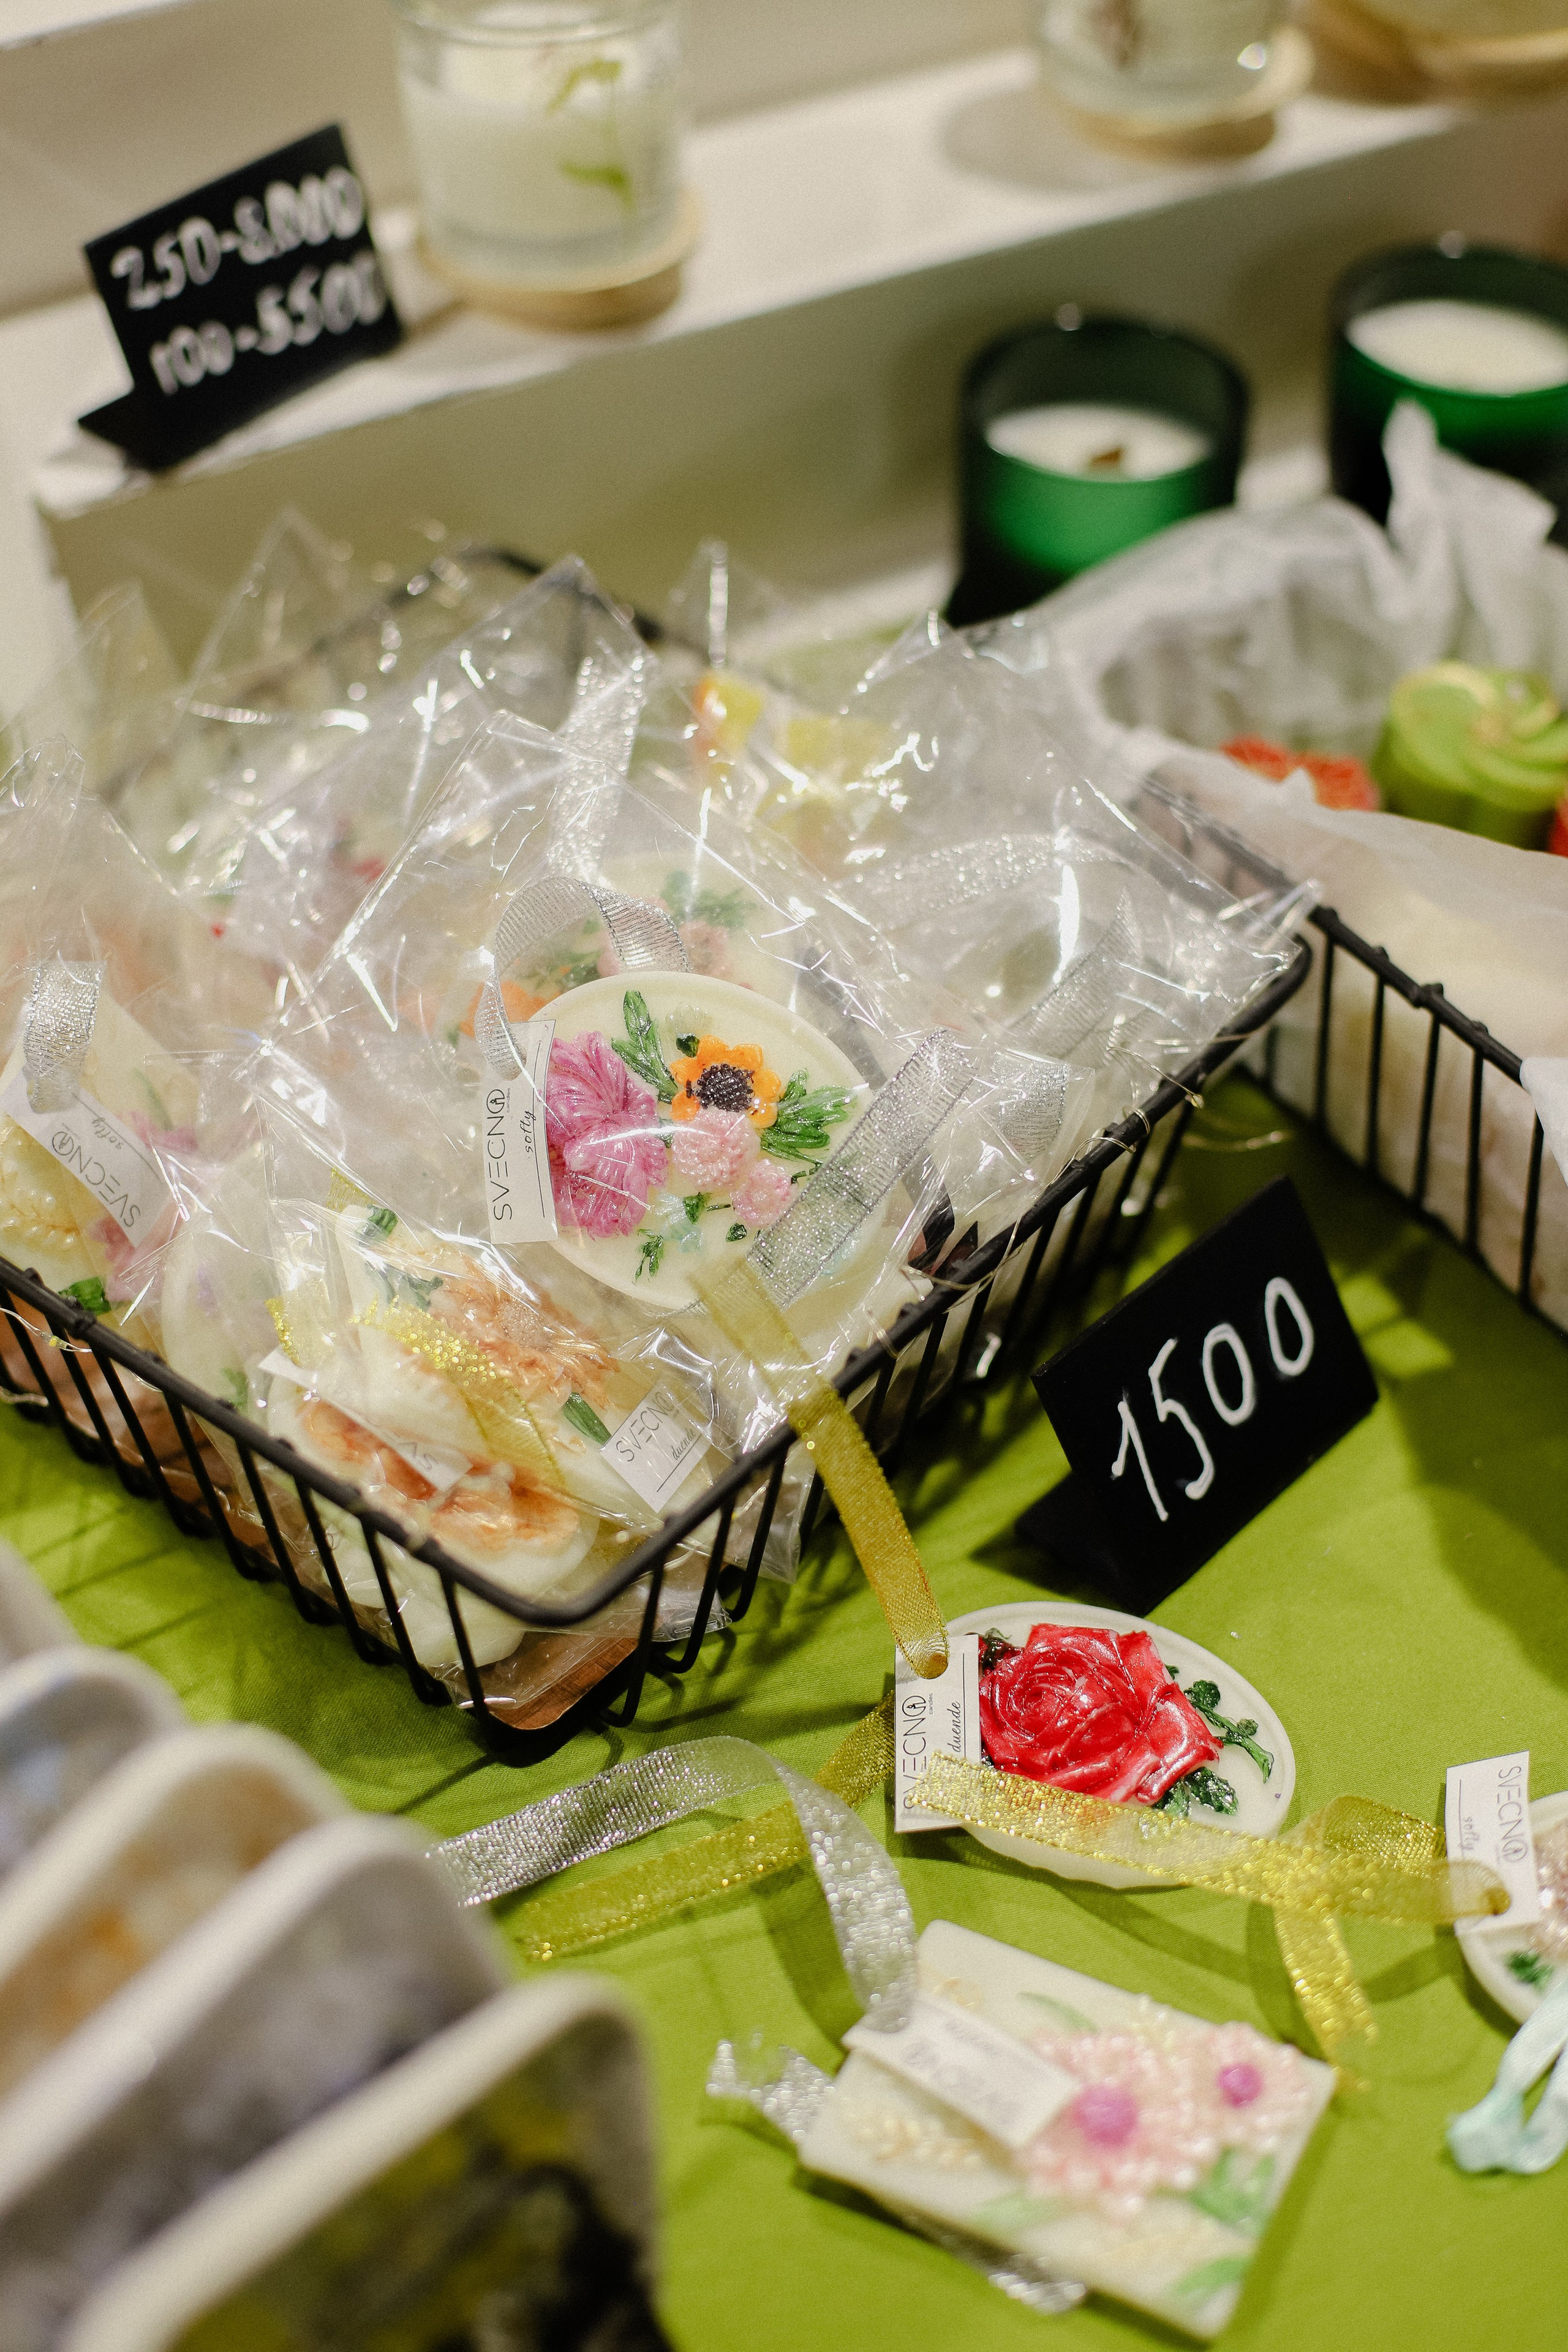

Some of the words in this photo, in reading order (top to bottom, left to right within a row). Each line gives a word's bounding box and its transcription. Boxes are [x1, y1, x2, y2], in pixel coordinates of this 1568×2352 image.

[519, 1110, 538, 1153] softy
[1110, 1276, 1315, 1521] 1500
[946, 1700, 961, 1753] duende
